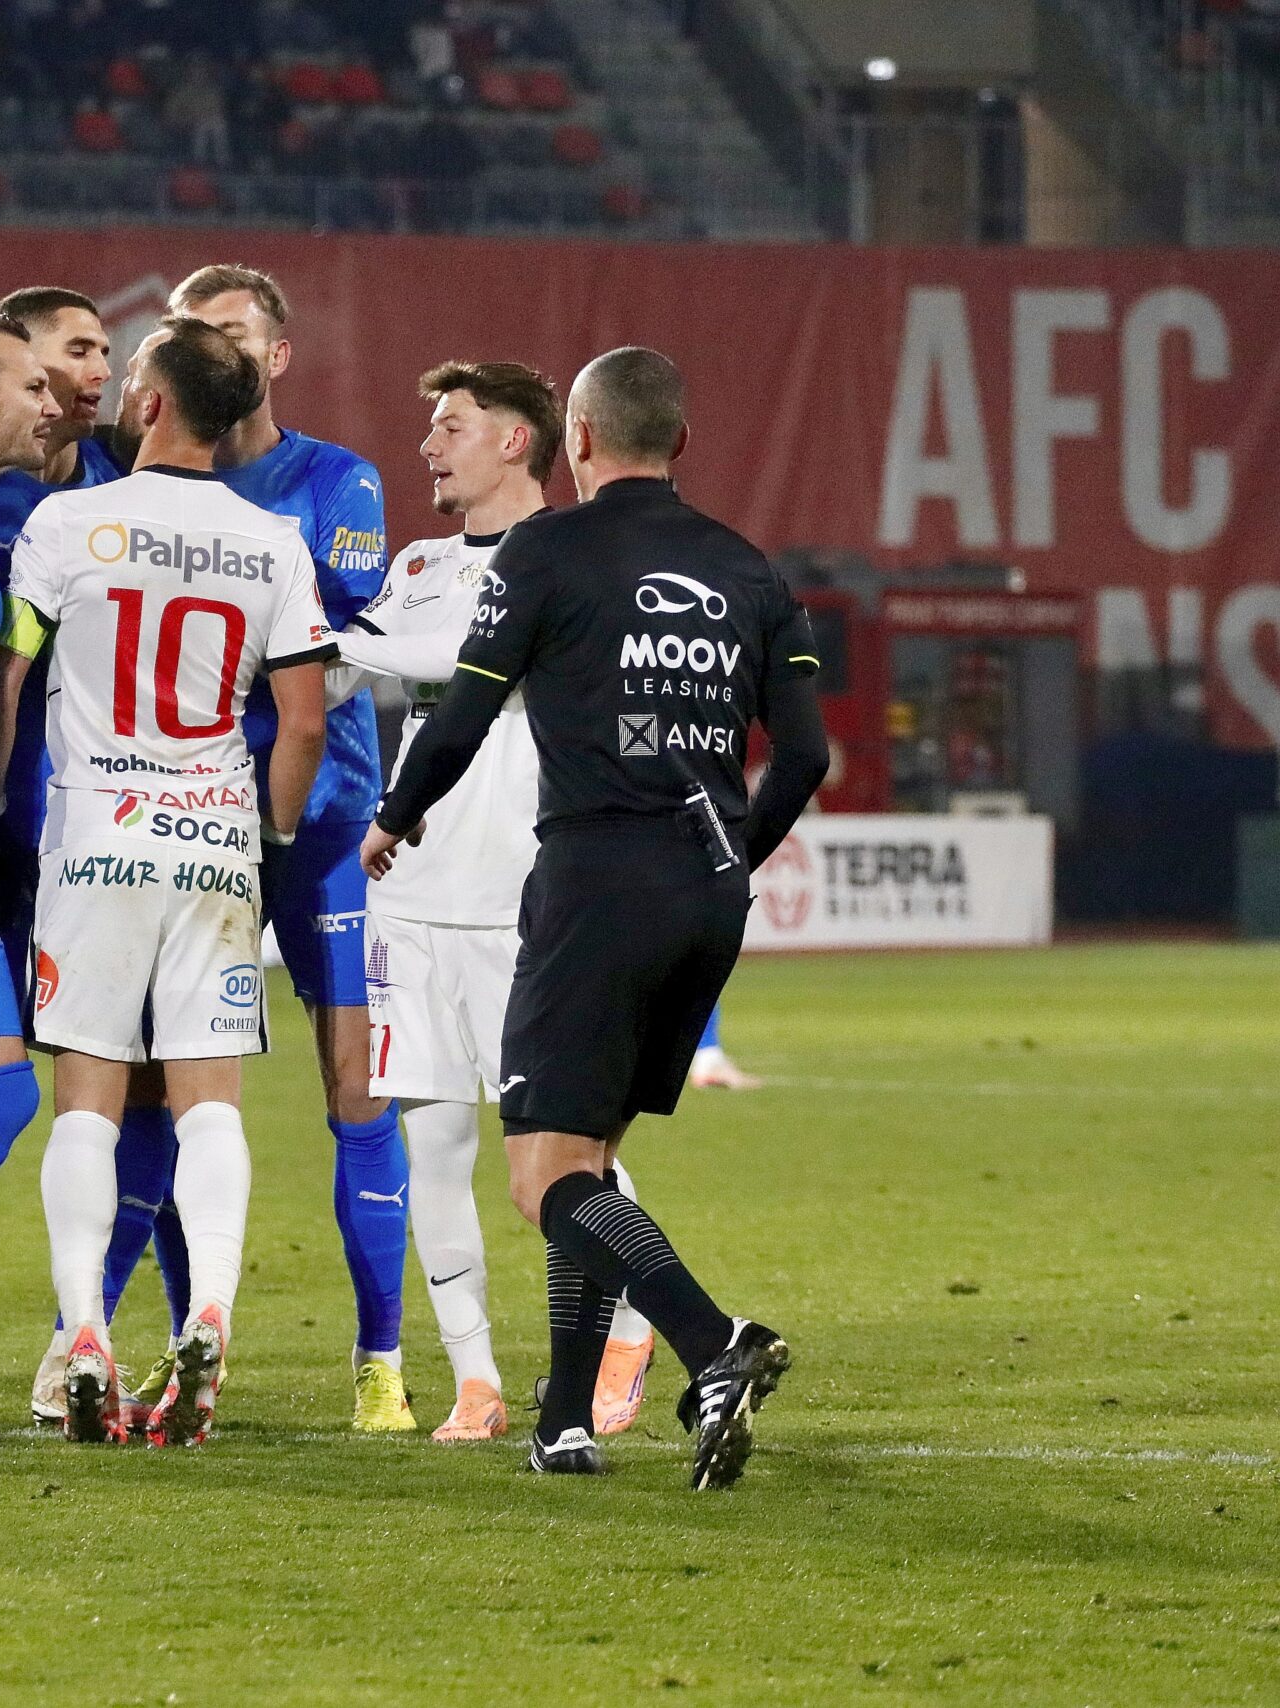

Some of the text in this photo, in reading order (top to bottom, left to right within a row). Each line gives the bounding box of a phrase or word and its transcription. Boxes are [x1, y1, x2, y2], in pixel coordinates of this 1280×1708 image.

[878, 286, 1232, 554] AFC
[128, 527, 275, 583] Palplast
[107, 587, 247, 740] 10
[620, 633, 741, 677] MOOV
[624, 678, 733, 702] LEASING
[150, 812, 250, 857] SOCAR
[59, 853, 160, 888] NATUR
[824, 844, 966, 885] TERRA
